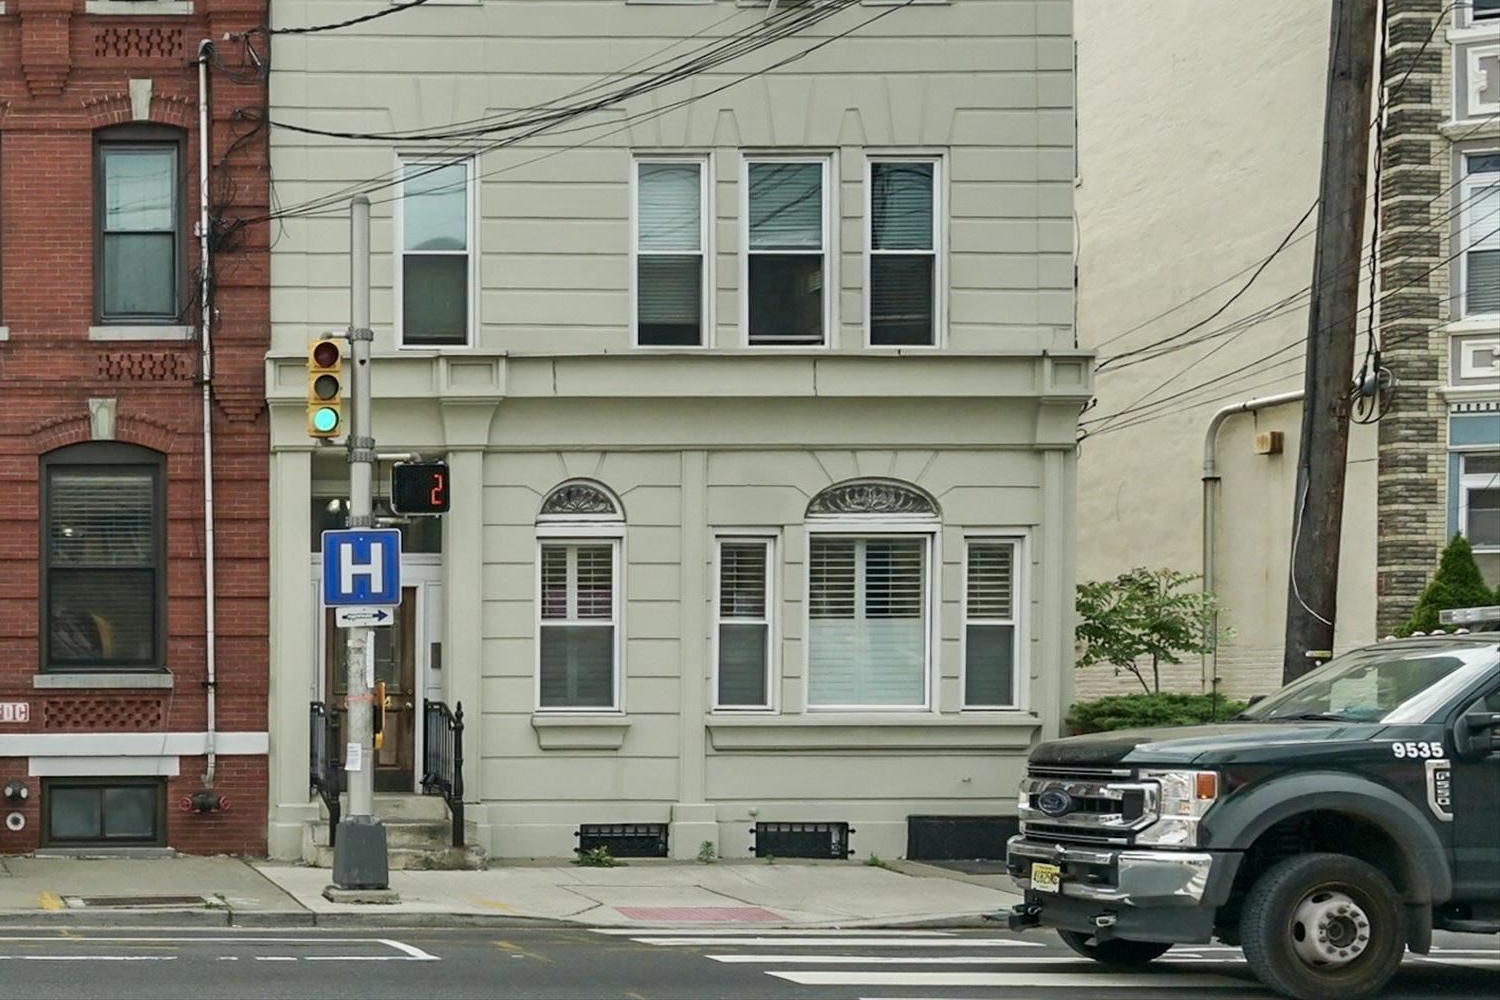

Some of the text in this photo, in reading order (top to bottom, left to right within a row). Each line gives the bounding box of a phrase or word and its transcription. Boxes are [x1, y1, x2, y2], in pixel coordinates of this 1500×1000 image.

[431, 474, 443, 505] 2
[340, 543, 383, 594] H
[1392, 742, 1444, 758] 9535
